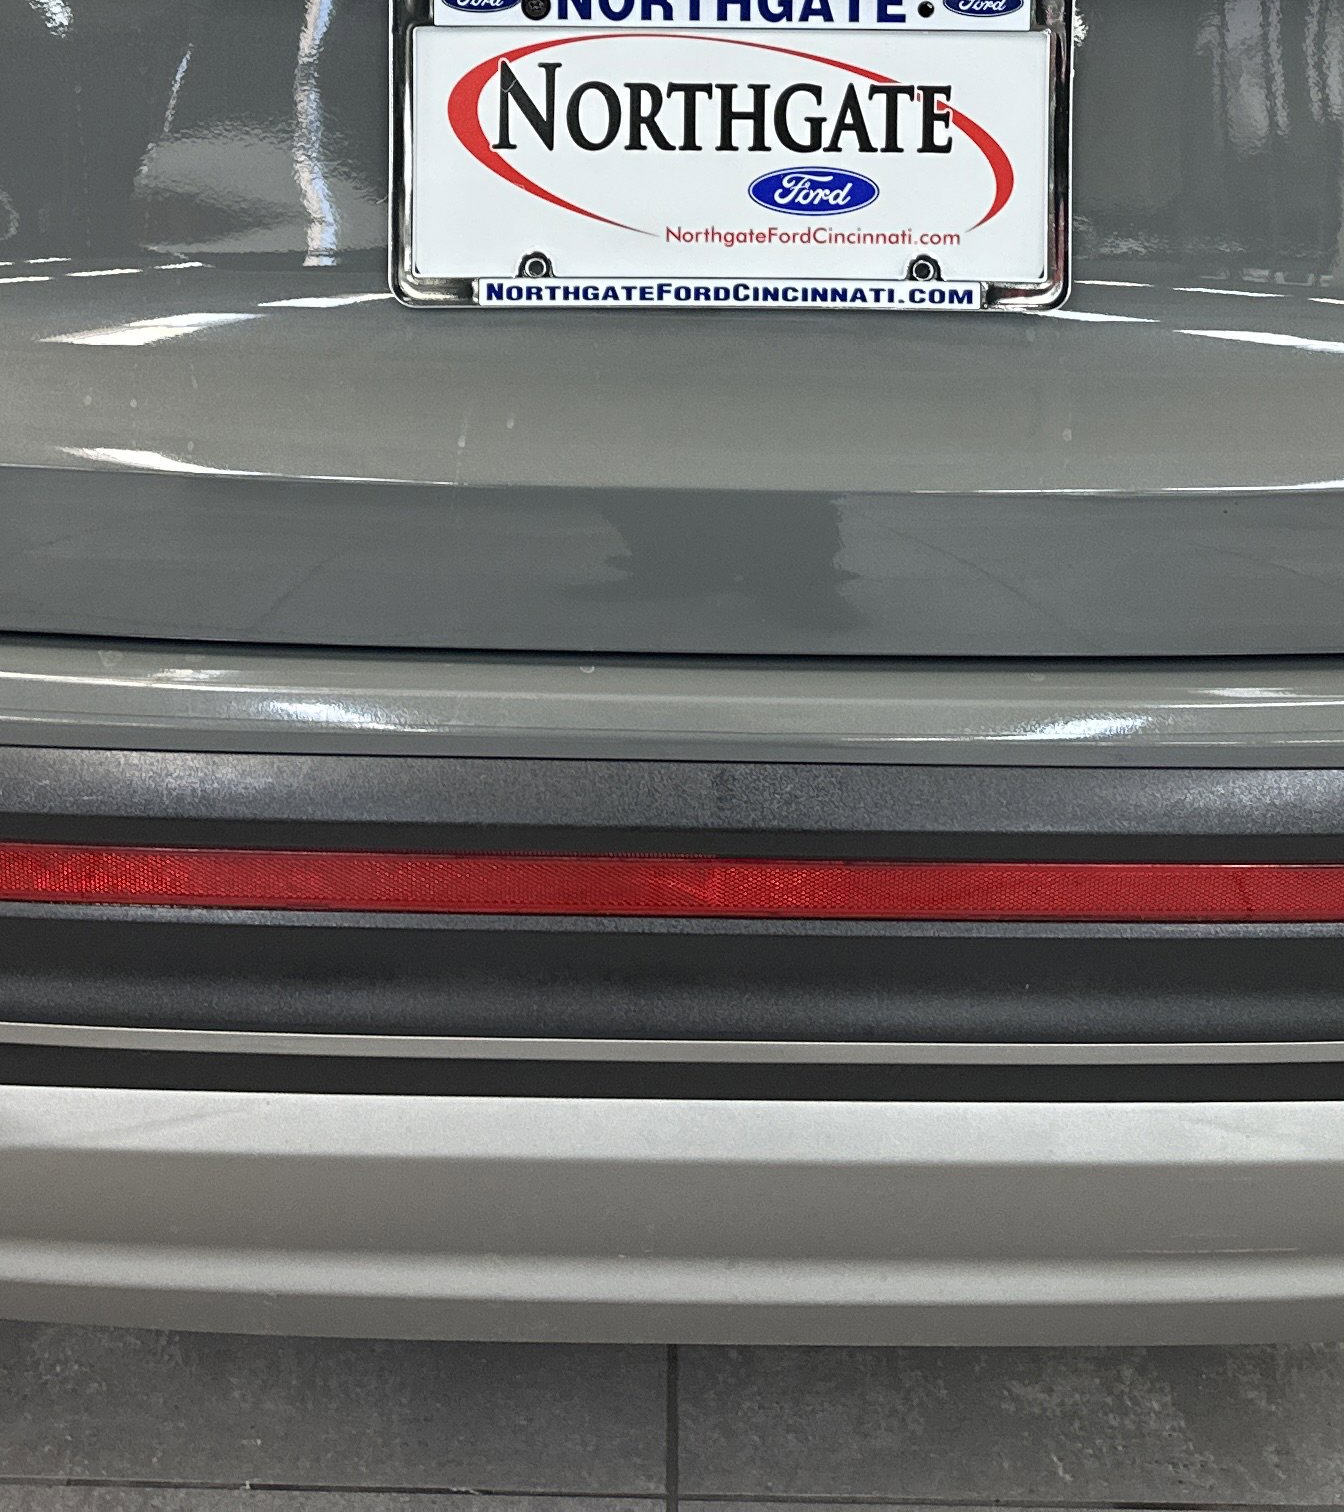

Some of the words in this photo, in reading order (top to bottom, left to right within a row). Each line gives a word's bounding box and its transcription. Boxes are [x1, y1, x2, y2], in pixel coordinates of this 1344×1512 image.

[491, 59, 953, 154] NORTHGATE
[773, 173, 854, 206] Ford
[665, 226, 960, 248] NorthgateFordCincinnati.com
